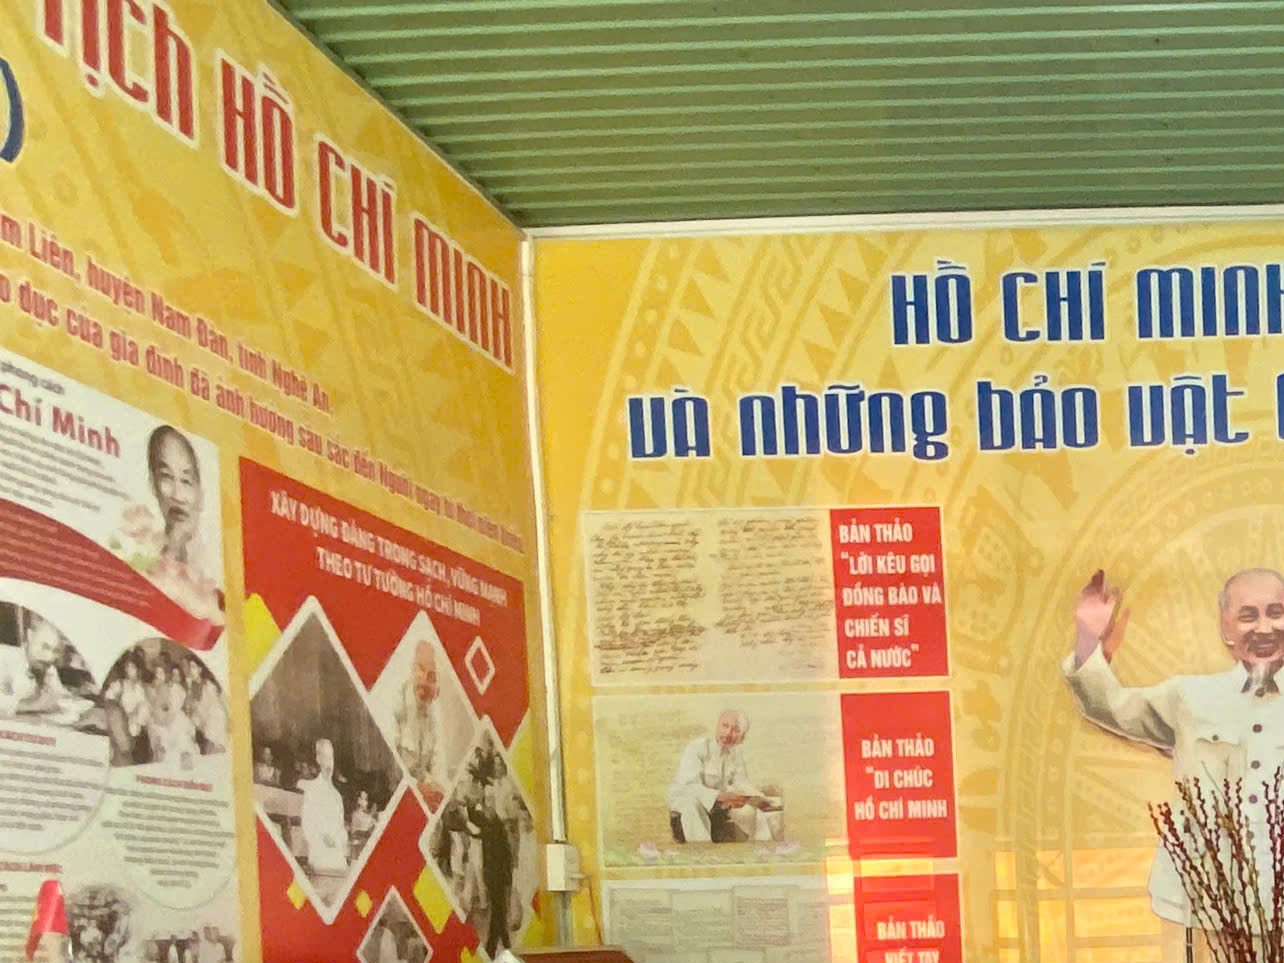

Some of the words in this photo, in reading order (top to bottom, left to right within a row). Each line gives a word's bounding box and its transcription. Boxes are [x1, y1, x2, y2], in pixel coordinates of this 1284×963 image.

[220, 57, 296, 210] HỒ
[318, 141, 396, 286] CHÍ
[414, 217, 513, 370] MINH
[151, 291, 191, 340] Nam
[891, 259, 973, 345] HỒ
[1002, 261, 1106, 342] CHÍ
[109, 329, 139, 367] gia
[52, 405, 120, 458] Minh
[839, 517, 870, 543] BẢN
[874, 517, 913, 543] THẢO
[317, 546, 352, 578] THEO
[877, 551, 906, 574] KÊU
[910, 553, 935, 577] GỌI
[843, 581, 884, 606] ĐỒNG
[888, 581, 918, 605] BÀO
[921, 581, 942, 604] VÀ
[845, 611, 890, 638] CHIẾN
[894, 612, 909, 637] SĨ
[846, 644, 866, 669] CẢ
[861, 732, 893, 758] BẢN
[897, 731, 934, 757] THẢO
[893, 765, 933, 788] CHÚC
[854, 797, 875, 820] HỒ
[879, 797, 904, 820] CHÍ
[908, 799, 948, 819] MINH
[877, 915, 907, 939] BẢN
[910, 913, 945, 939] THẢO
